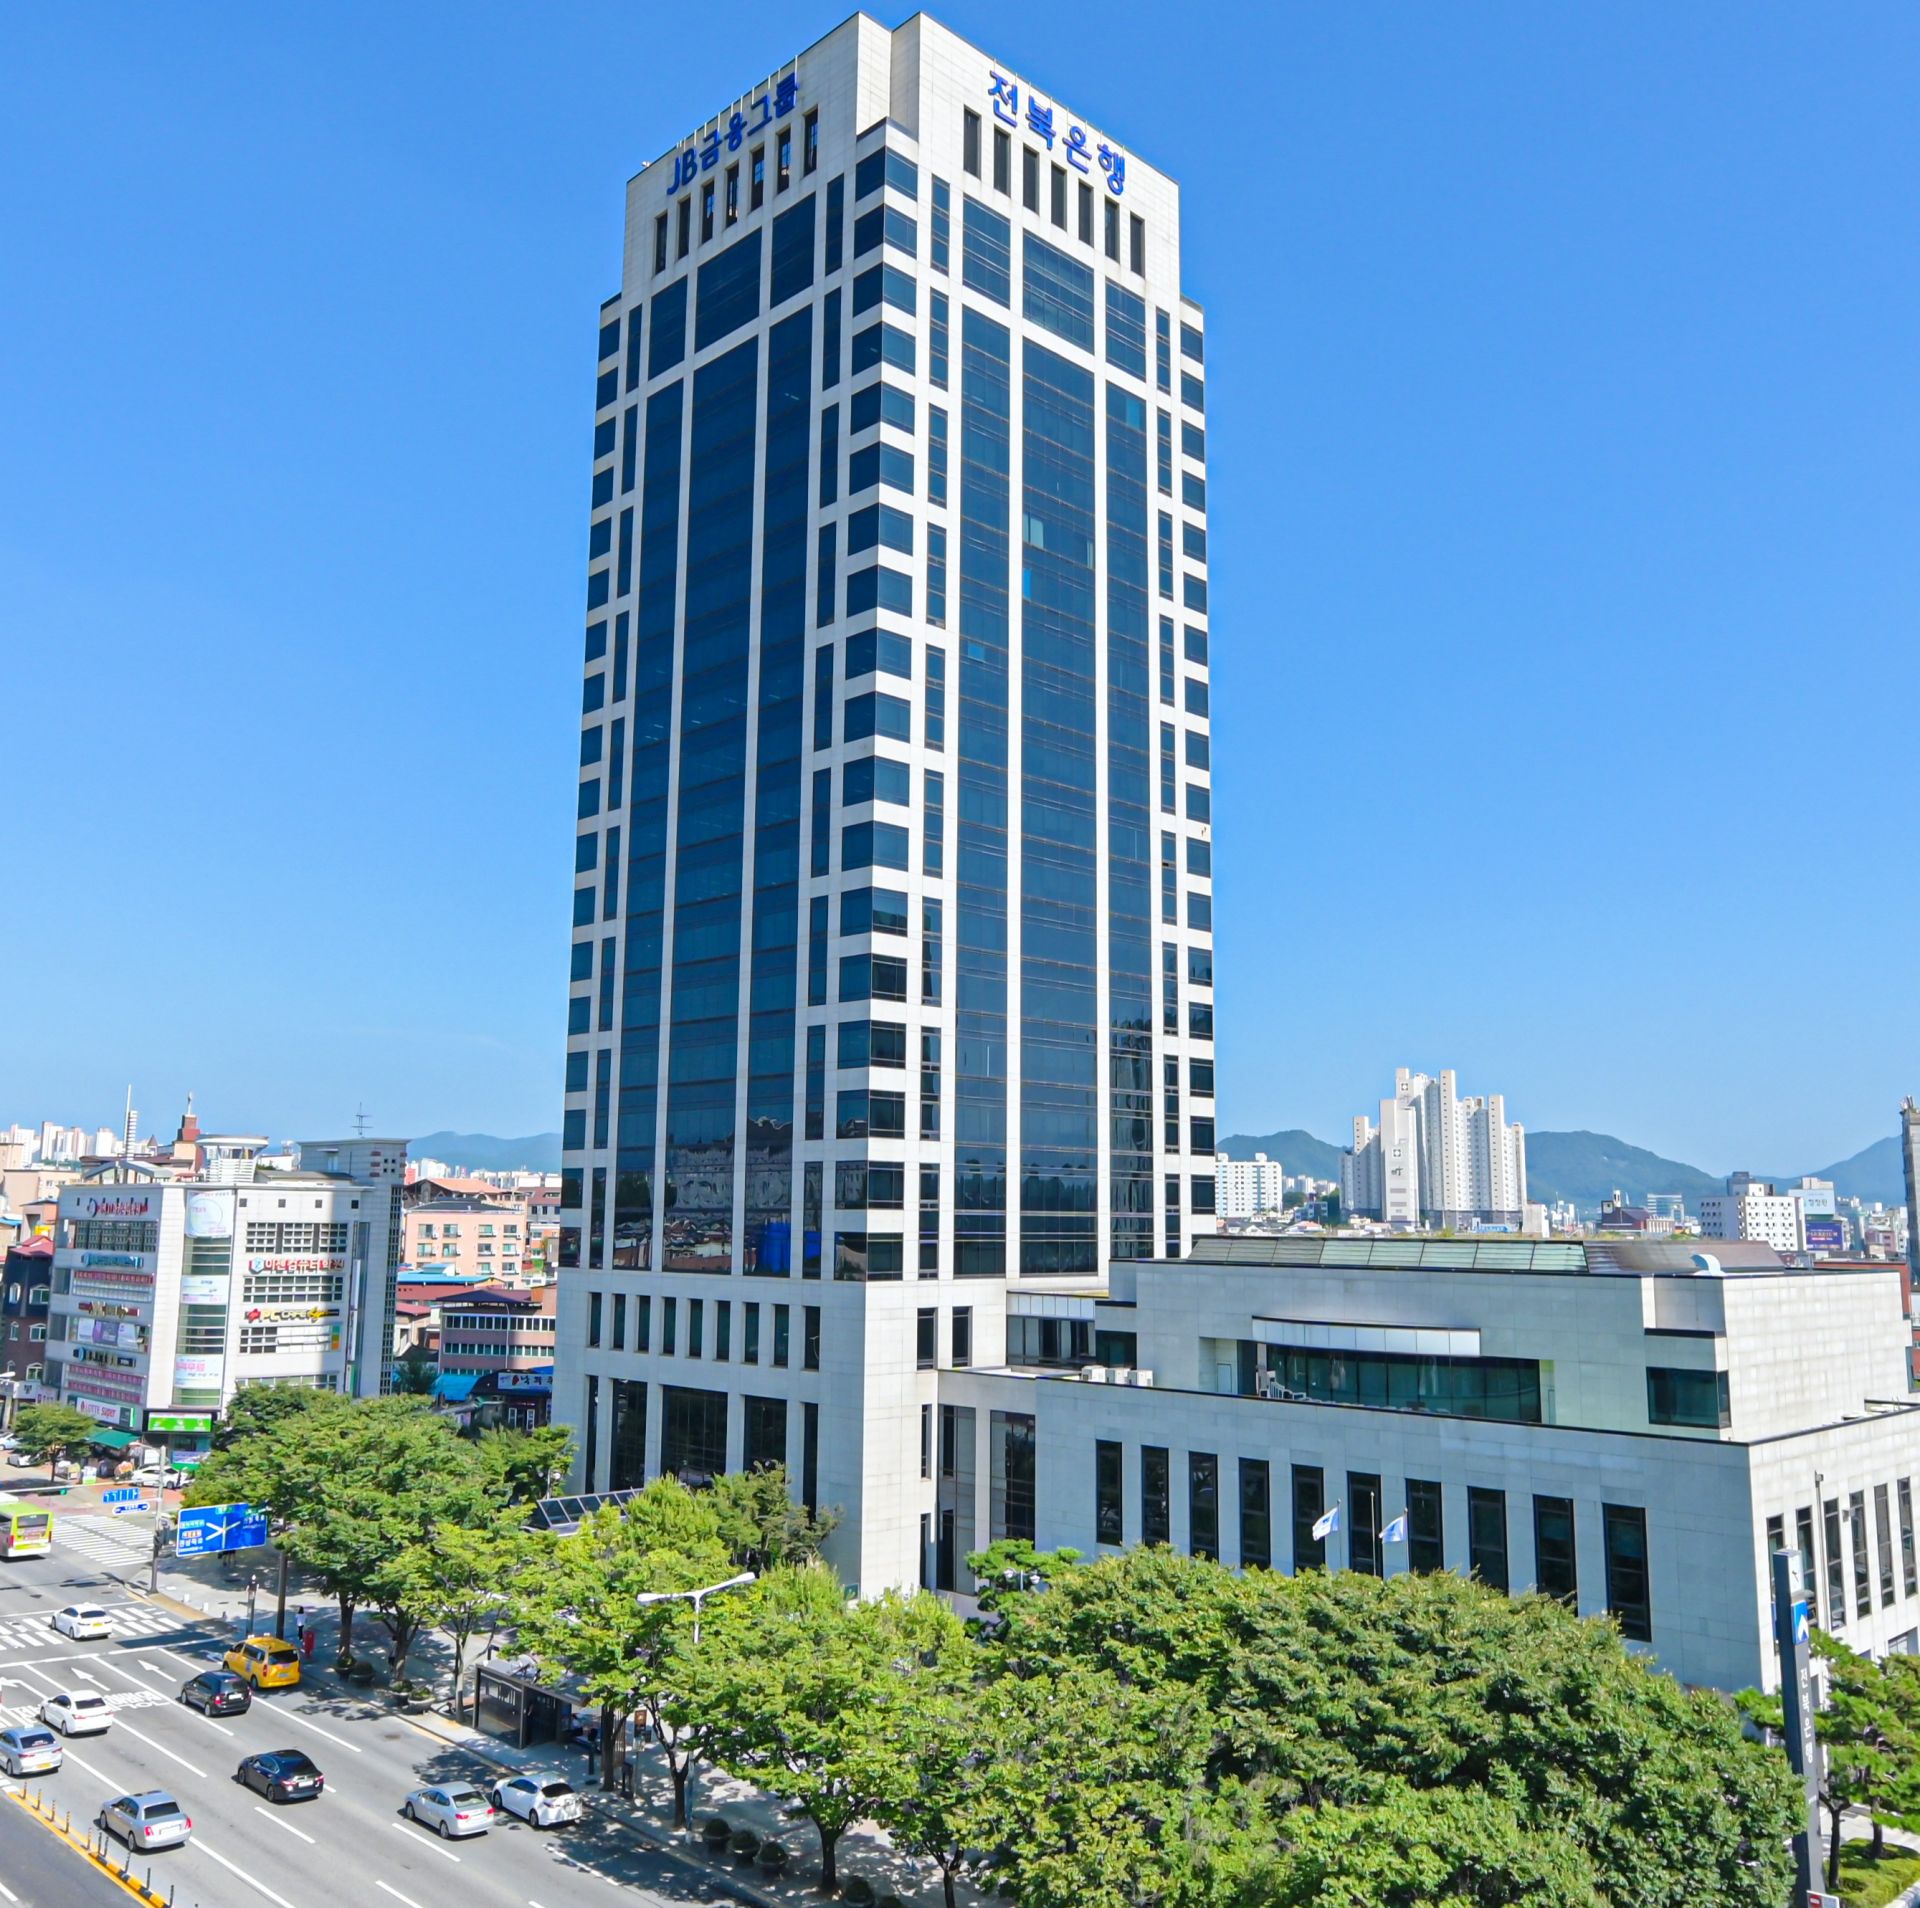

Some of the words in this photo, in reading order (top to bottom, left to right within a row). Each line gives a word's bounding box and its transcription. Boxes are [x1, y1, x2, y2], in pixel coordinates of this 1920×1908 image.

[667, 71, 799, 195] JB금융그룹
[988, 71, 1126, 195] 전북은행
[1800, 1667, 1813, 1764] 전북은행
